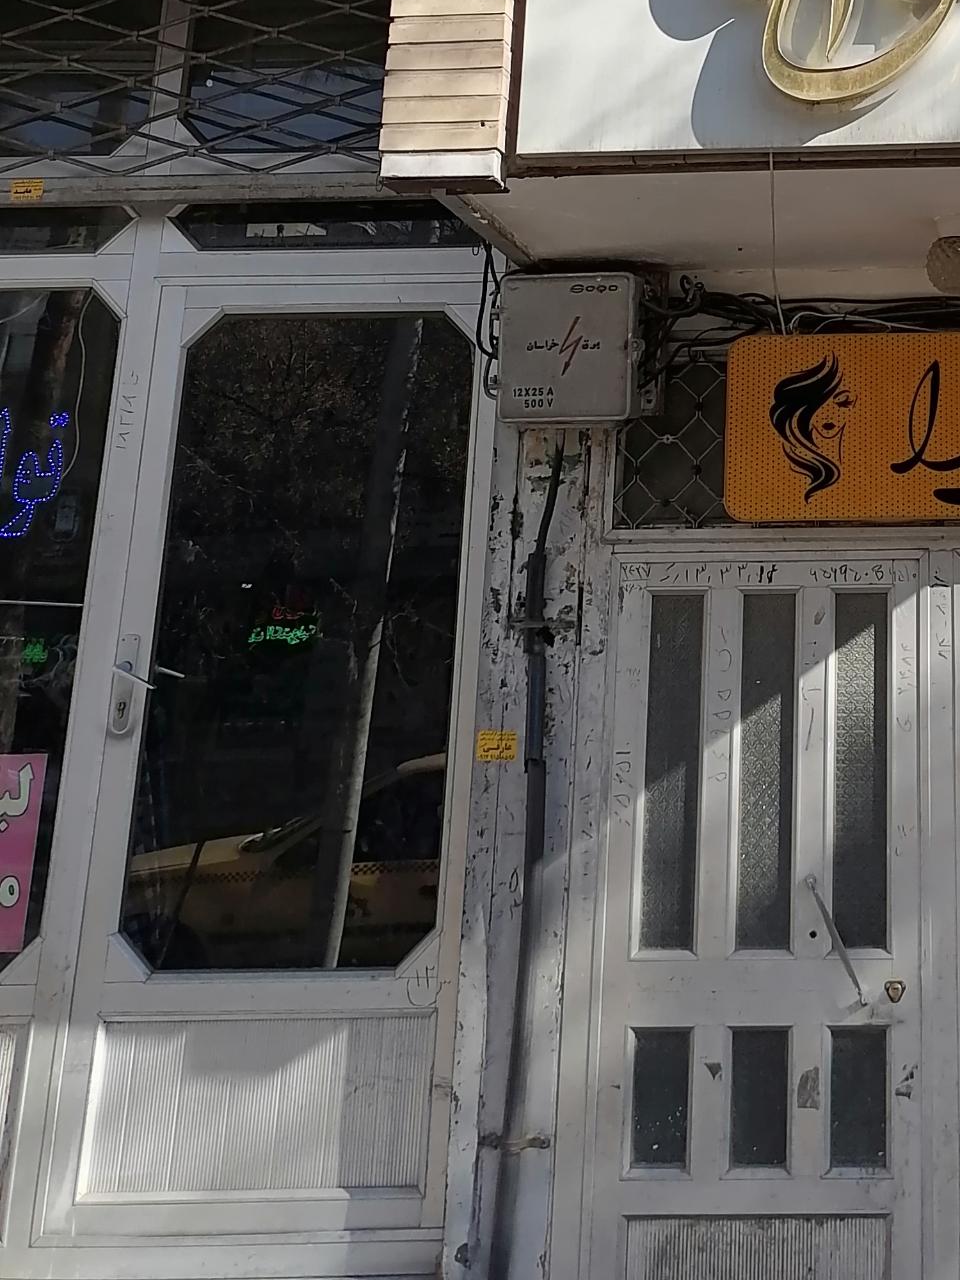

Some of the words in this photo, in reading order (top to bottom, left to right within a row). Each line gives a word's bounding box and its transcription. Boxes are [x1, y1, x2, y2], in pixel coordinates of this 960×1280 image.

[547, 387, 554, 396] A
[524, 399, 544, 408] 500
[548, 398, 554, 408] V
